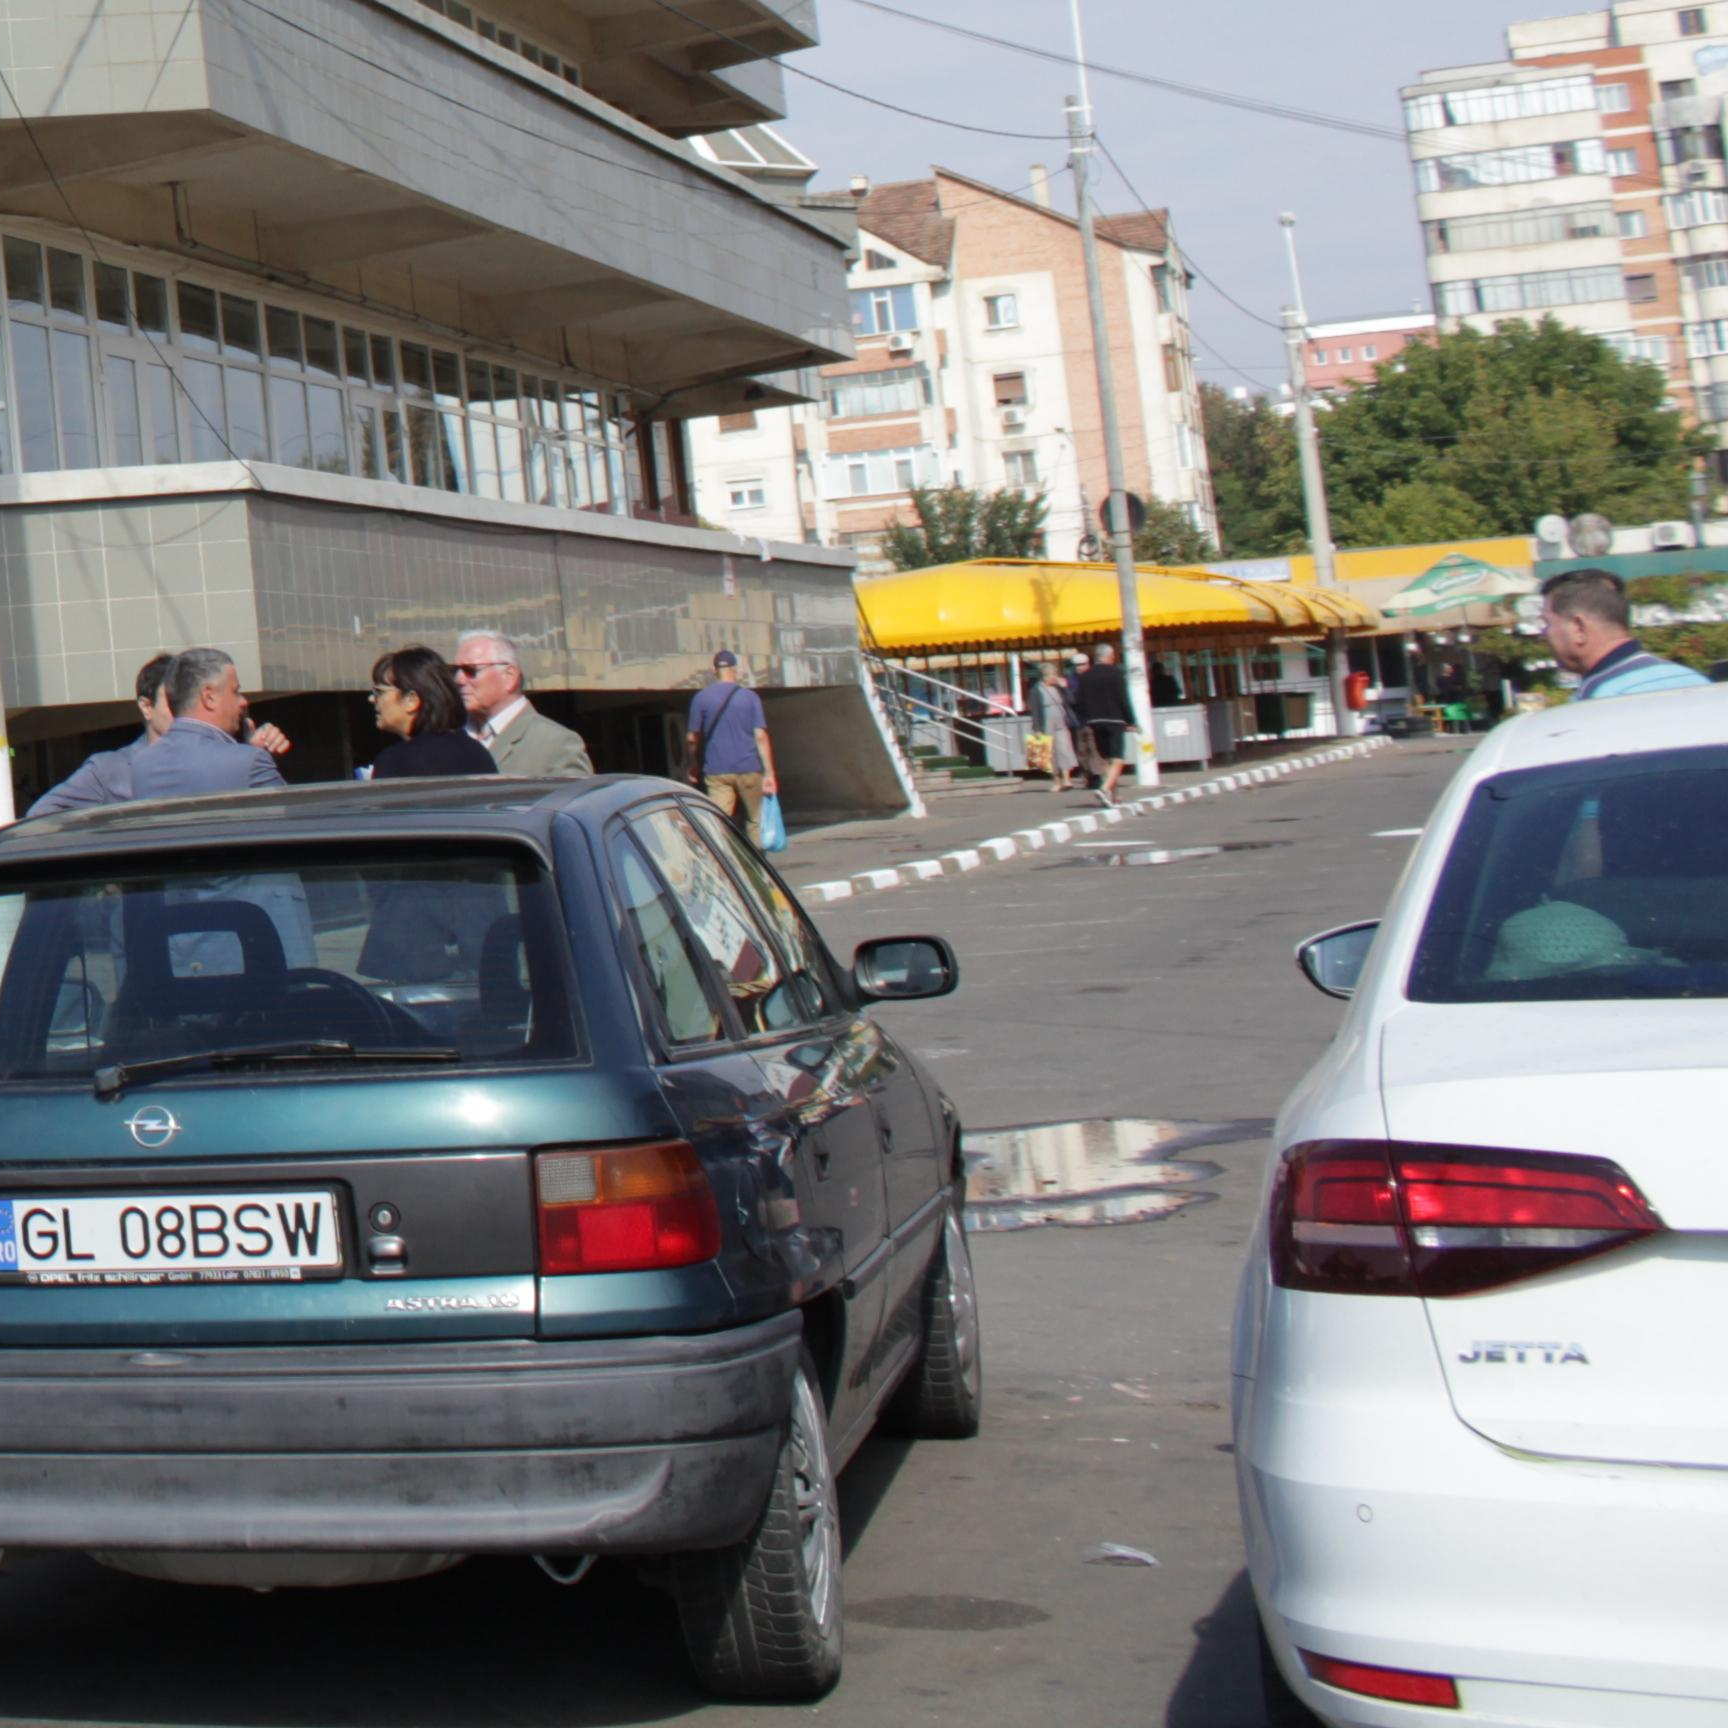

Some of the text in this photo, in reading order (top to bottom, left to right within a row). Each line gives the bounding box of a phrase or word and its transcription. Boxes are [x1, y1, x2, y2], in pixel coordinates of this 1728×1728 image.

[21, 1207, 95, 1261] GL
[40, 1272, 74, 1283] OPEL
[384, 1295, 478, 1311] ASTRA
[1458, 1341, 1589, 1365] JETTA
